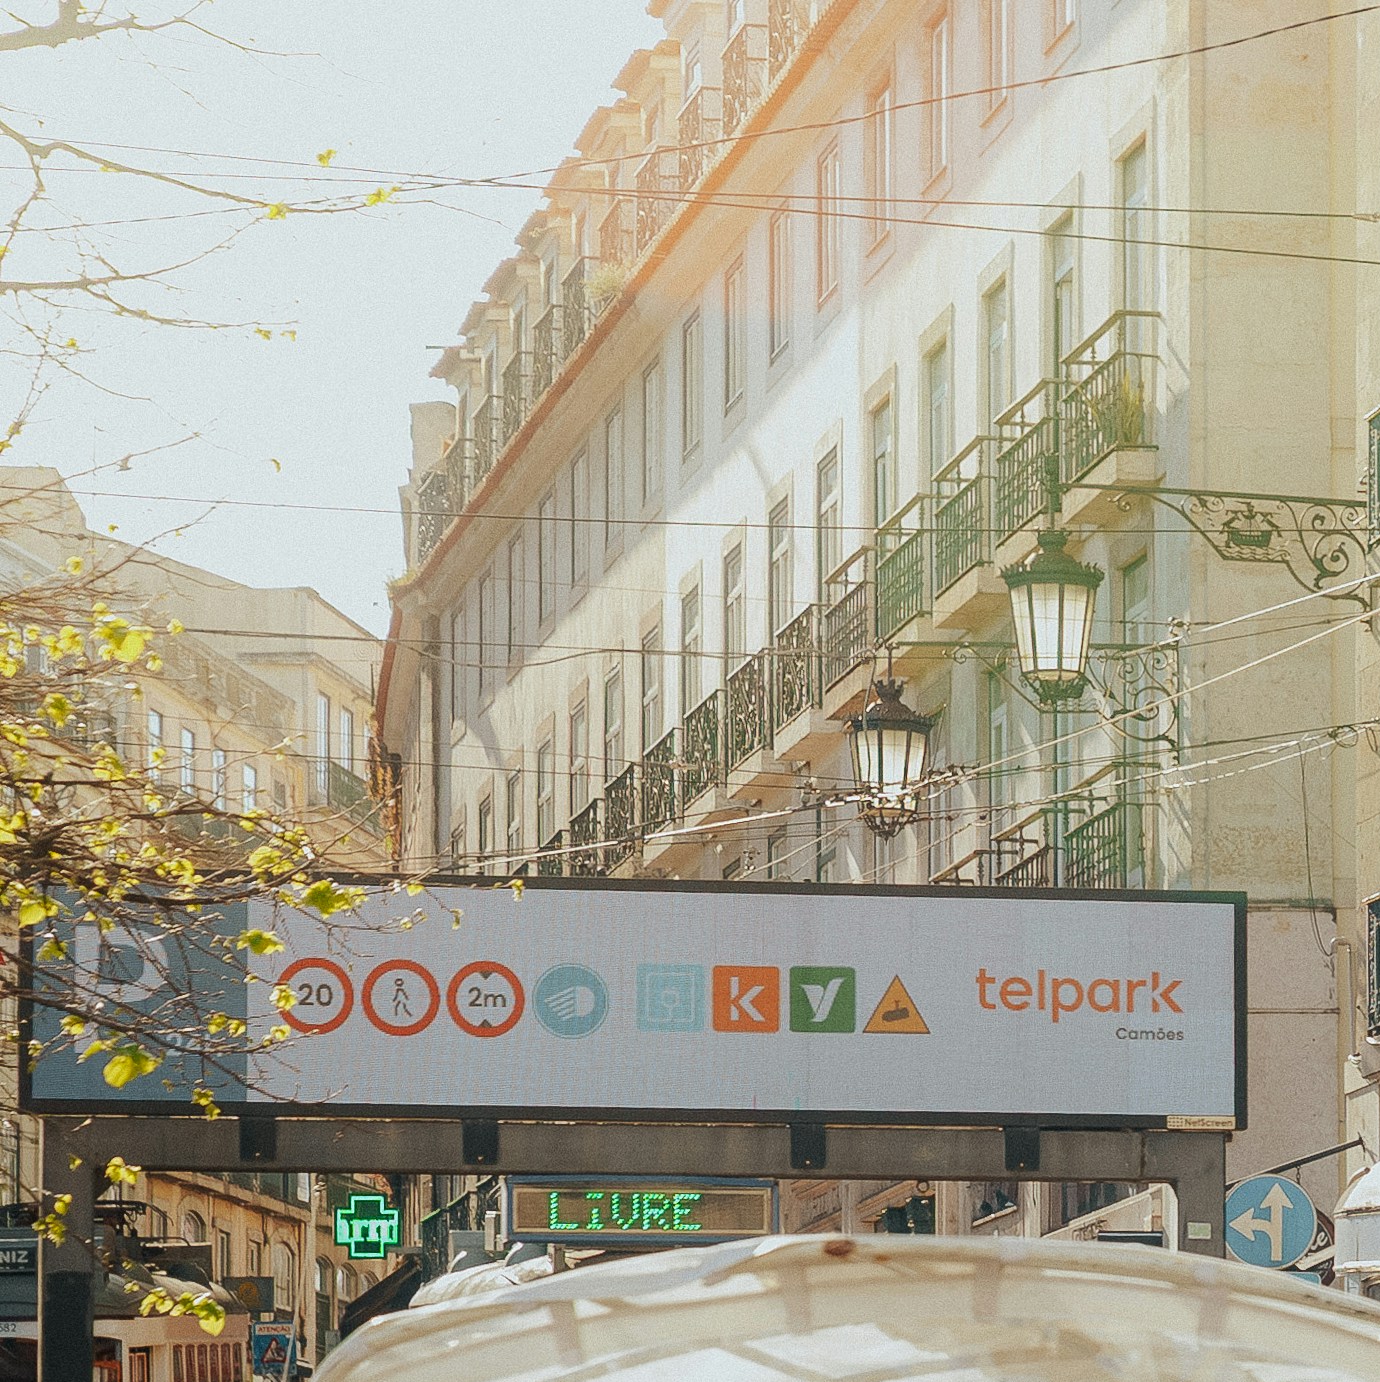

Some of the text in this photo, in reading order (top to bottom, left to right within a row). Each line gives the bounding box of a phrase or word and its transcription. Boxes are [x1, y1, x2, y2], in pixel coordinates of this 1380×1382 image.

[297, 983, 334, 1008] 20
[467, 986, 508, 1008] 2m
[975, 967, 1185, 1024] telpark
[1115, 1027, 1185, 1041] Camões
[1184, 1118, 1234, 1127] NetScreen
